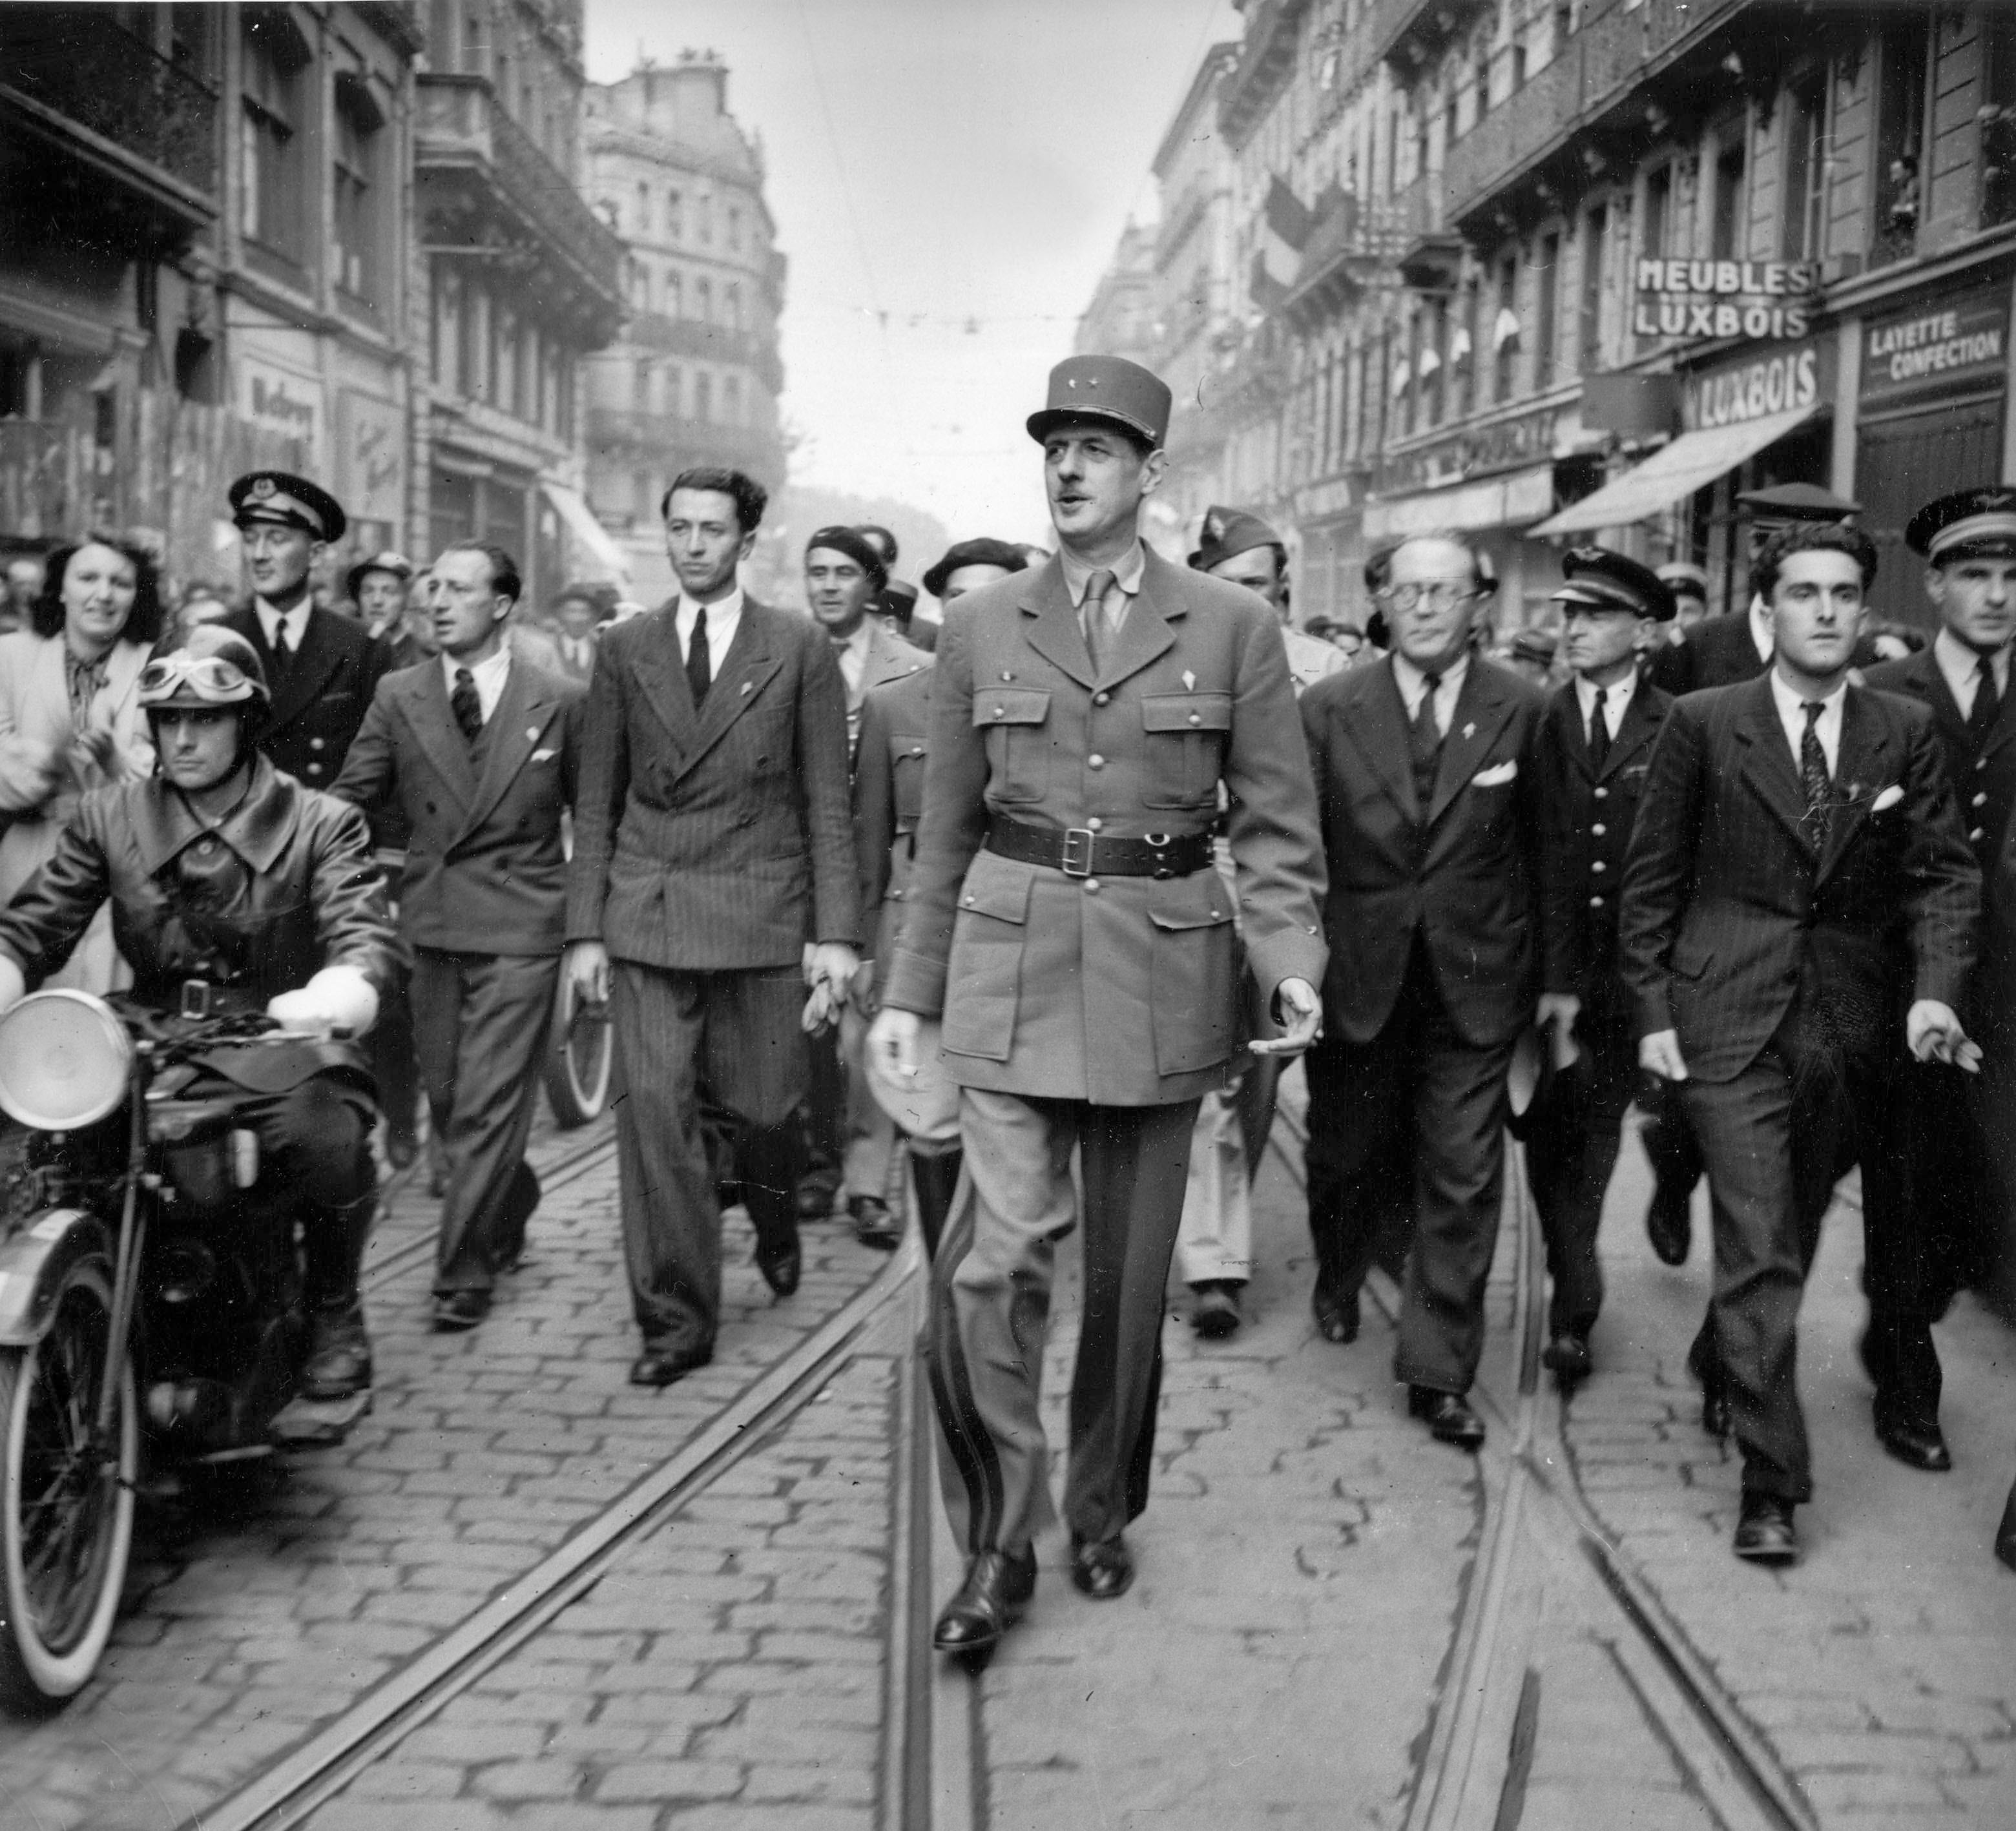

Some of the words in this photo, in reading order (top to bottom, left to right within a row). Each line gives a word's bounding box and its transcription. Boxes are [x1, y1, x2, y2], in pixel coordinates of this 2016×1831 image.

[1639, 259, 1810, 293] MEUBLES
[1636, 304, 1808, 338] LUXBOIS
[1871, 312, 1956, 356] LAYETTE
[1891, 329, 2000, 380] CONFECTION
[1701, 349, 1816, 426] LUXBOIS
